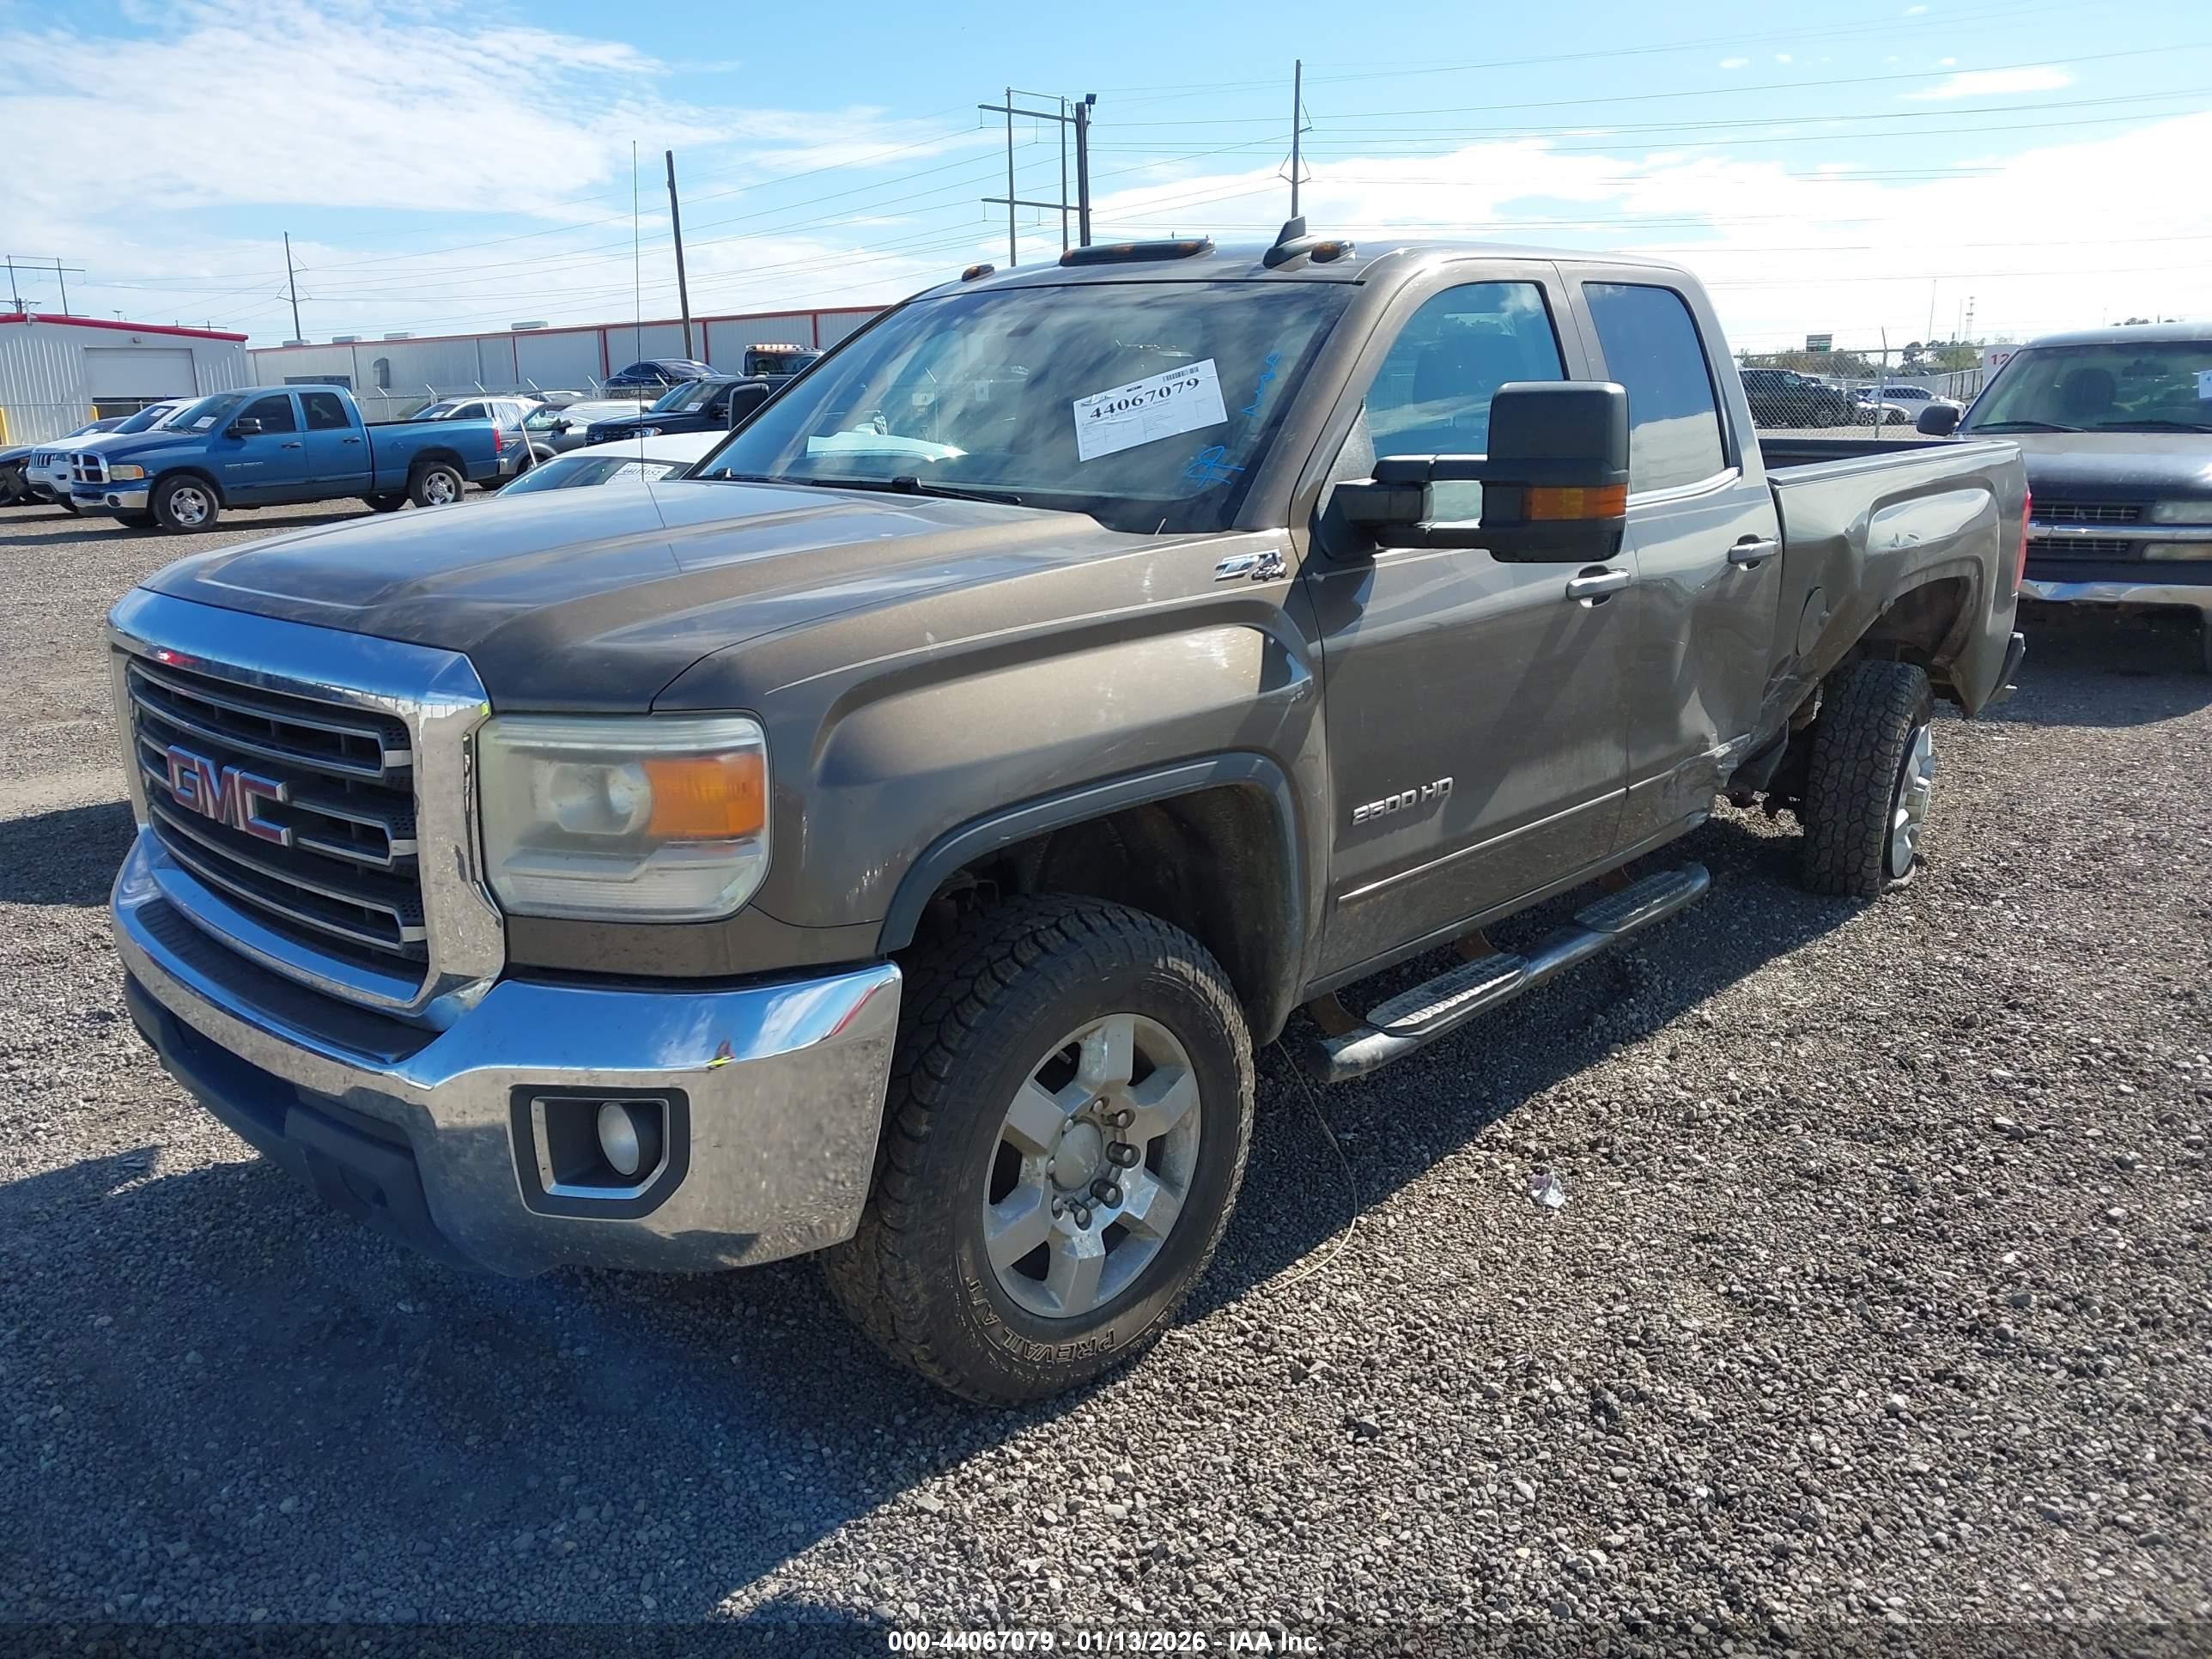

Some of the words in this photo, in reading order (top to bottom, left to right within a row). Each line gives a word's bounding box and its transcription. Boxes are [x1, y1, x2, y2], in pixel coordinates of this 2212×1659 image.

[1090, 377, 1200, 419] 44067079
[166, 744, 292, 848] GMC
[1352, 789, 1418, 826] 2500
[1420, 776, 1454, 804] HD
[1002, 1326, 1117, 1364] PREVAIL
